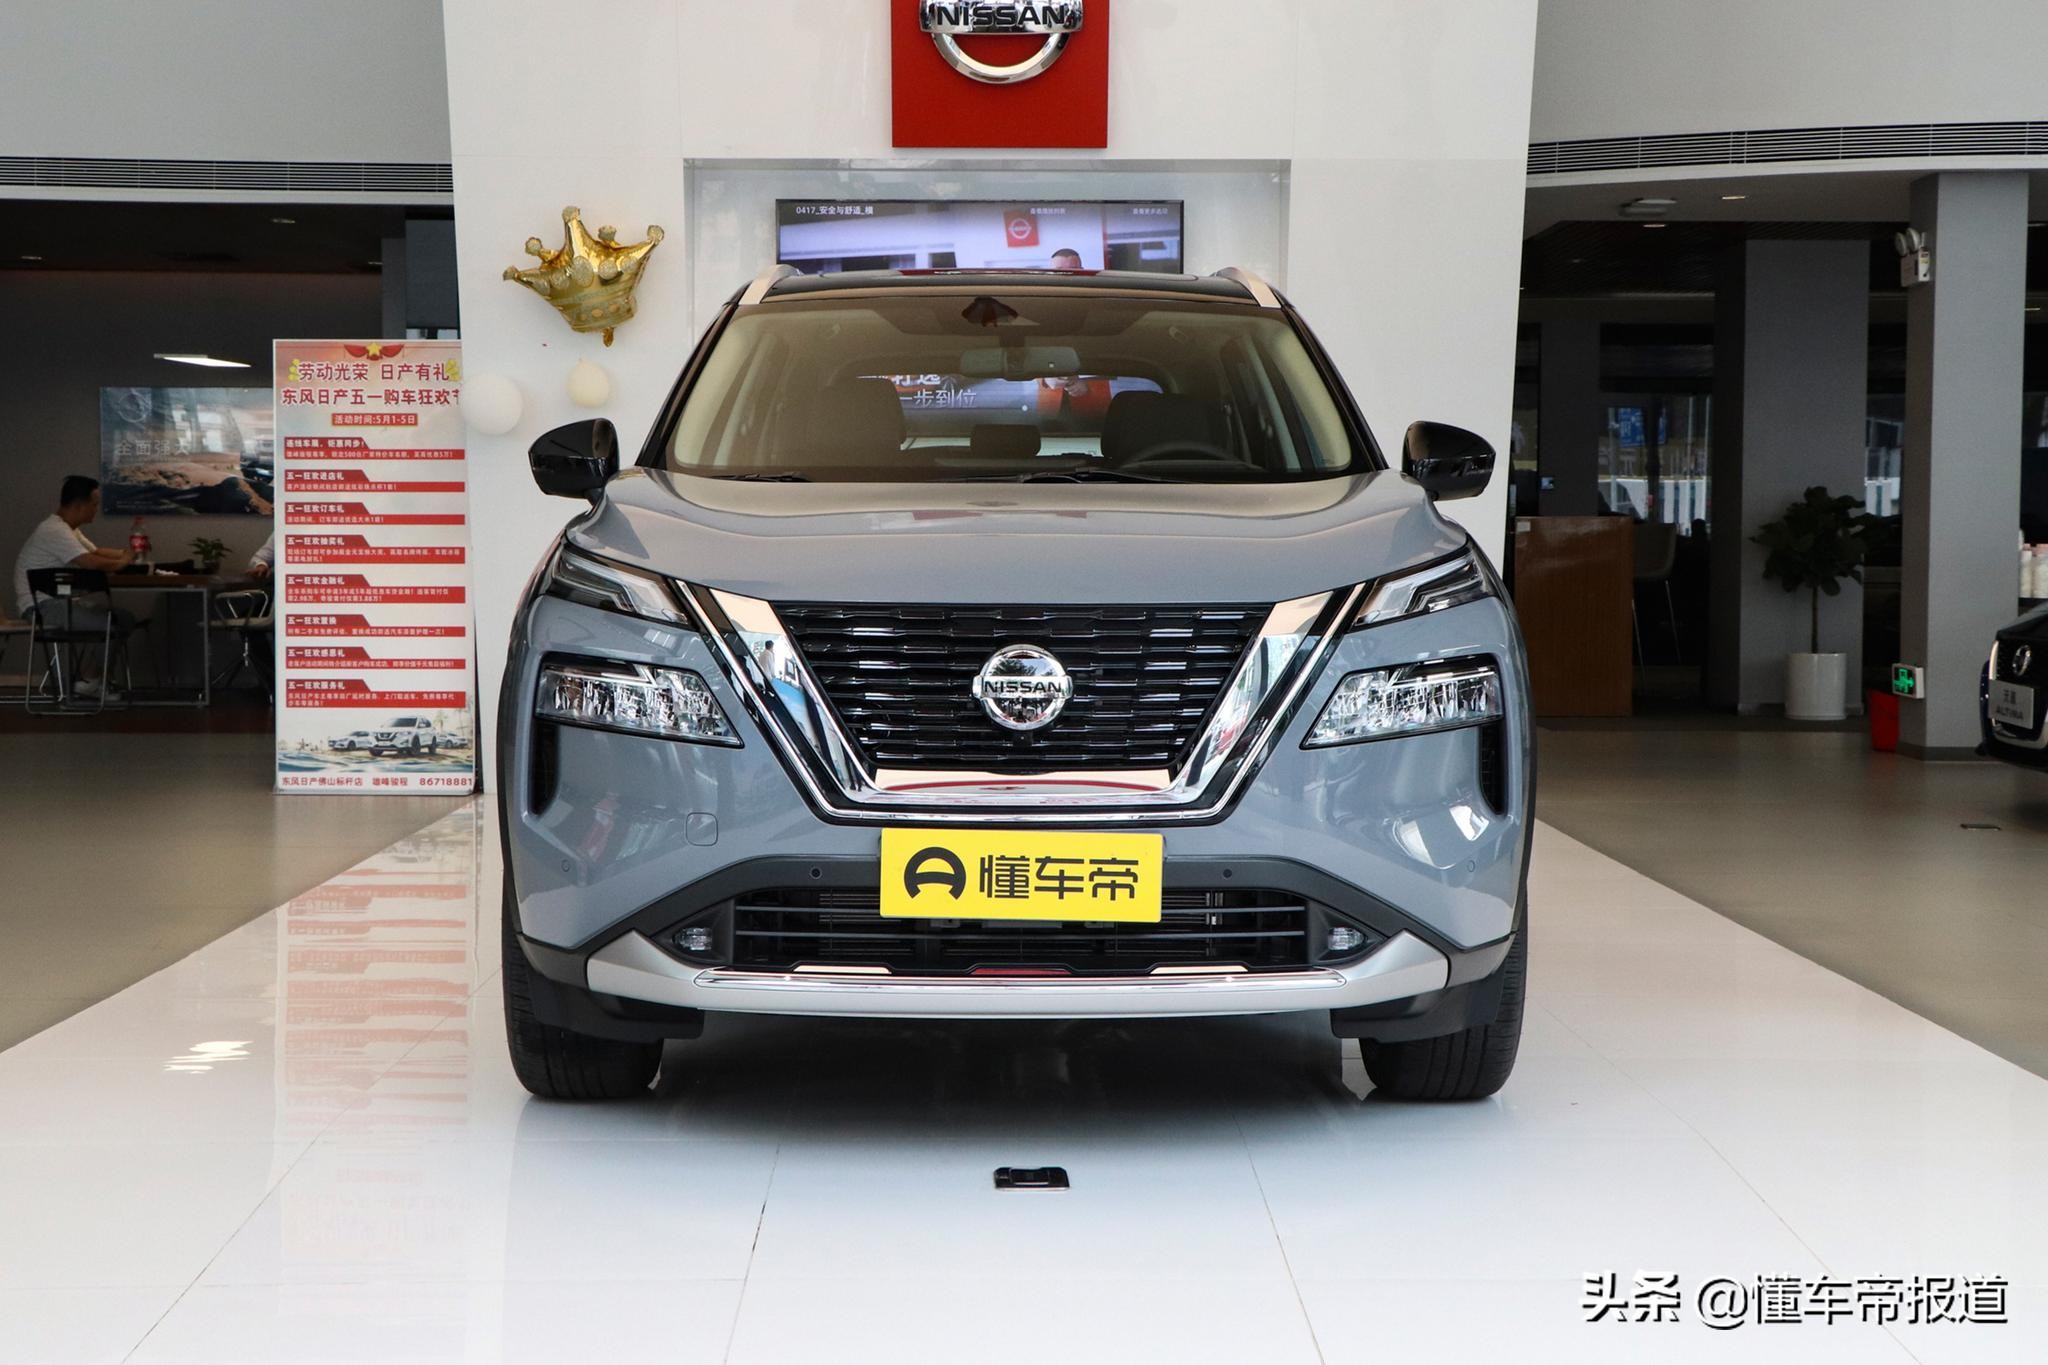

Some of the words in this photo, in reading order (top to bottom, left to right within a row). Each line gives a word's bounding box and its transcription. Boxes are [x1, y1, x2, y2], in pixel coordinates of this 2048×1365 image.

[936, 5, 1065, 27] NISSAN
[299, 362, 369, 381] 劳动光荣
[380, 362, 450, 381] 日产有礼
[899, 389, 977, 408] 一步到位
[286, 504, 345, 513] 五一狂欢订车礼
[984, 680, 1062, 693] NISSAN
[419, 777, 473, 786] 86718881
[979, 854, 1139, 901] 懂车帝
